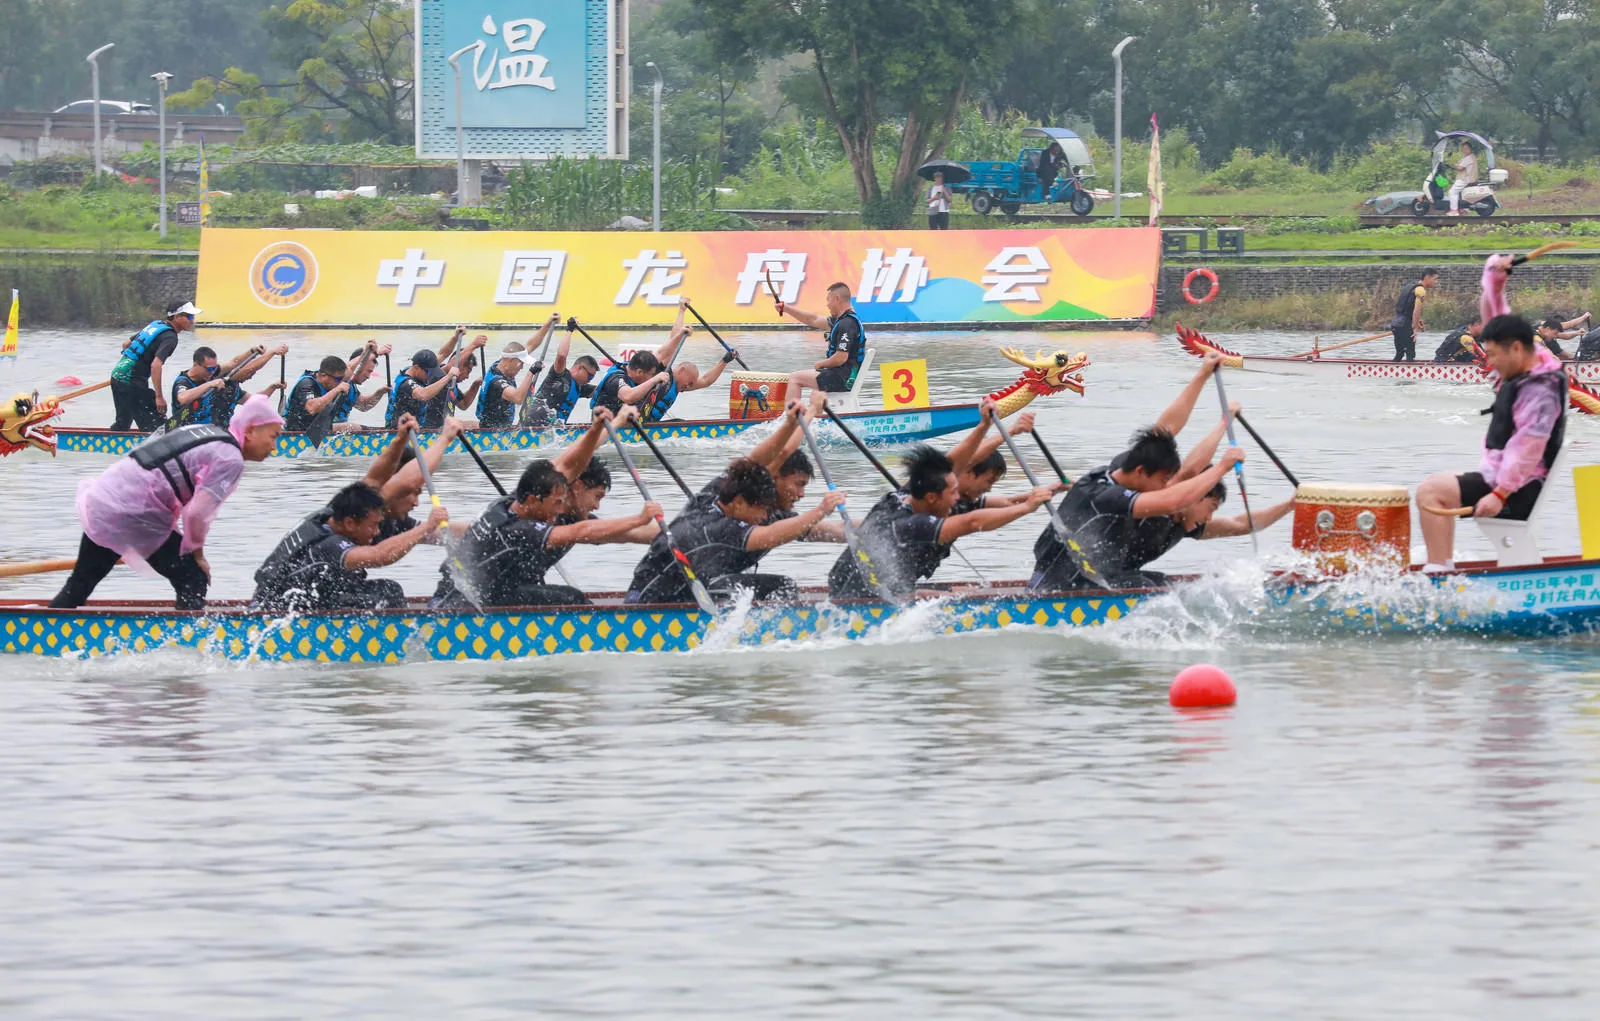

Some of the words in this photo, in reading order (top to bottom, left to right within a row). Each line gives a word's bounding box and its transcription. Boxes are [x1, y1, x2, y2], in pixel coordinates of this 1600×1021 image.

[473, 14, 556, 92] 温
[376, 246, 1051, 305] 中国龙舟协会
[892, 368, 917, 405] 3
